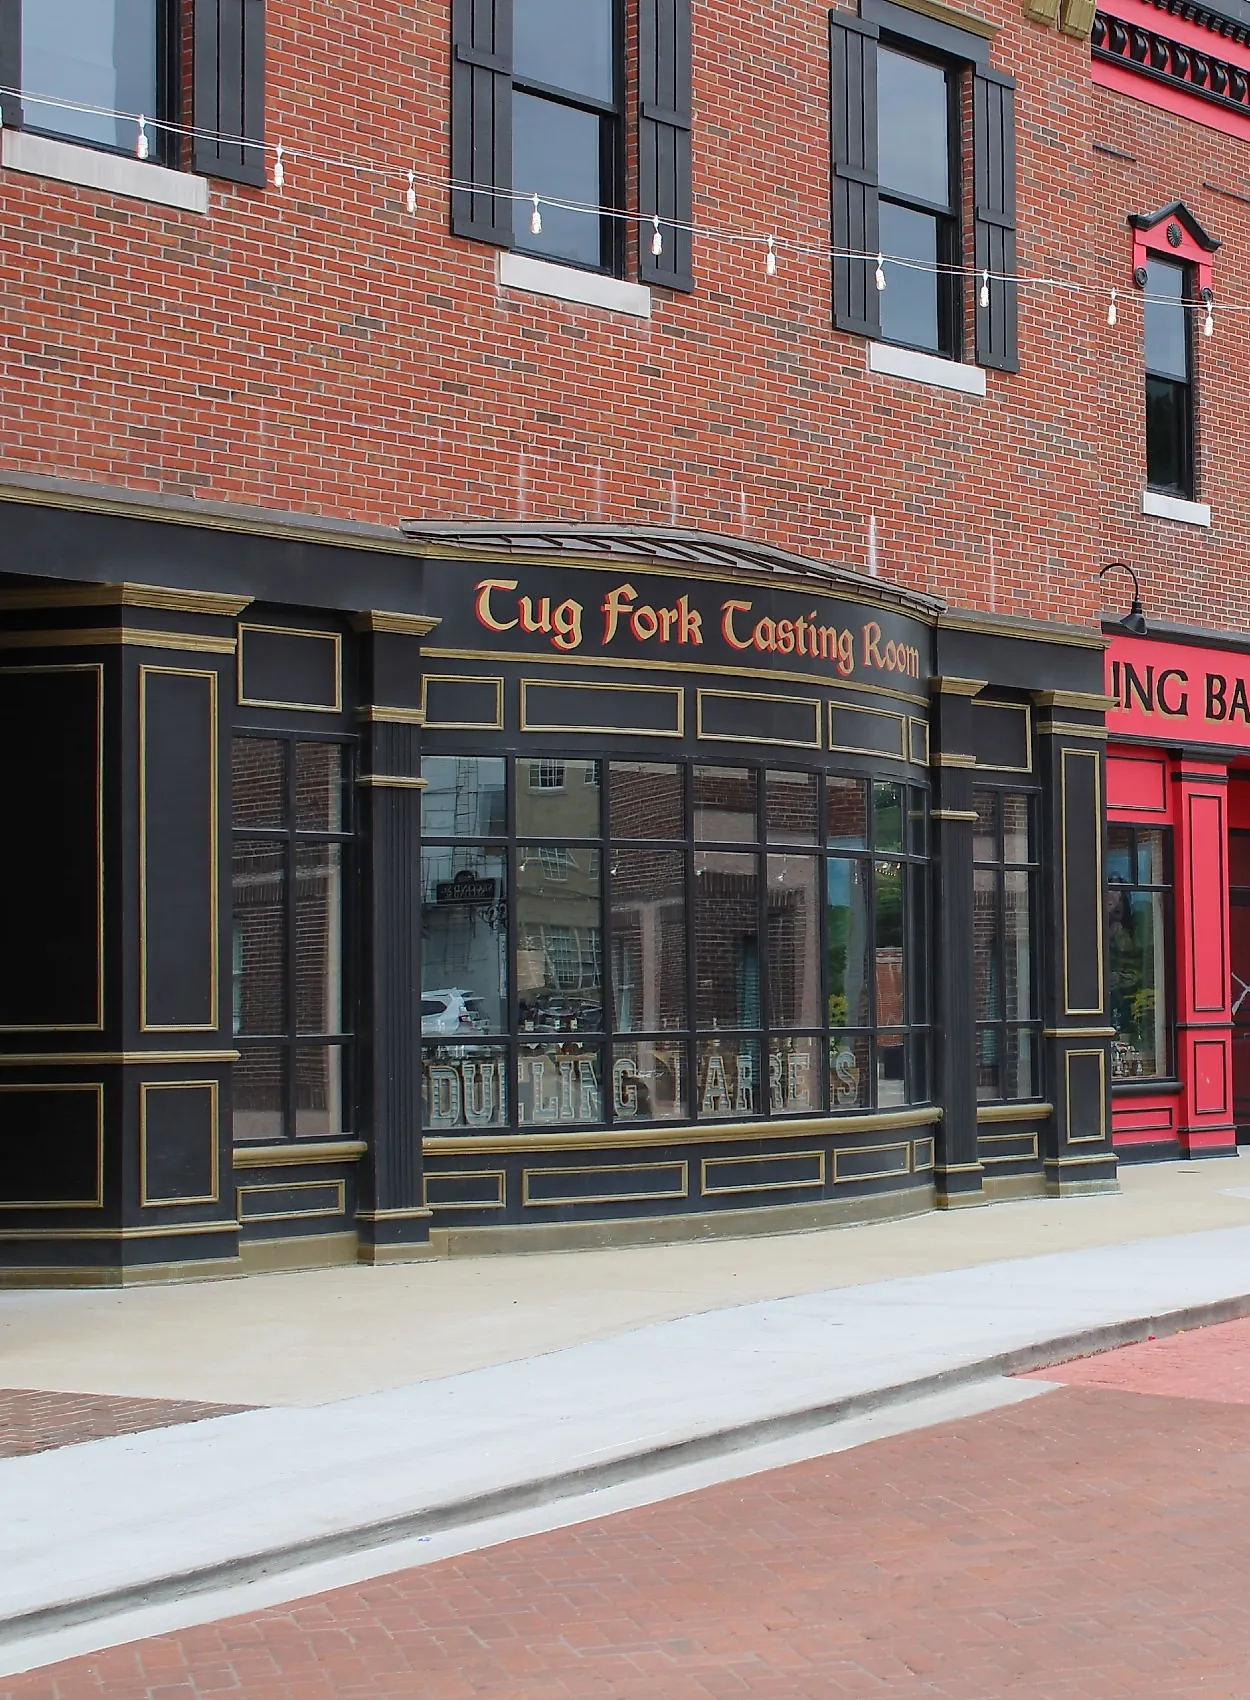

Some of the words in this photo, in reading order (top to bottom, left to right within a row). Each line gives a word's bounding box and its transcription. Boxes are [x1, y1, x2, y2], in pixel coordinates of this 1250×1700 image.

[473, 578, 584, 652] Tug
[601, 583, 703, 645] Fork
[720, 600, 855, 677] Tasting
[863, 621, 919, 679] Room
